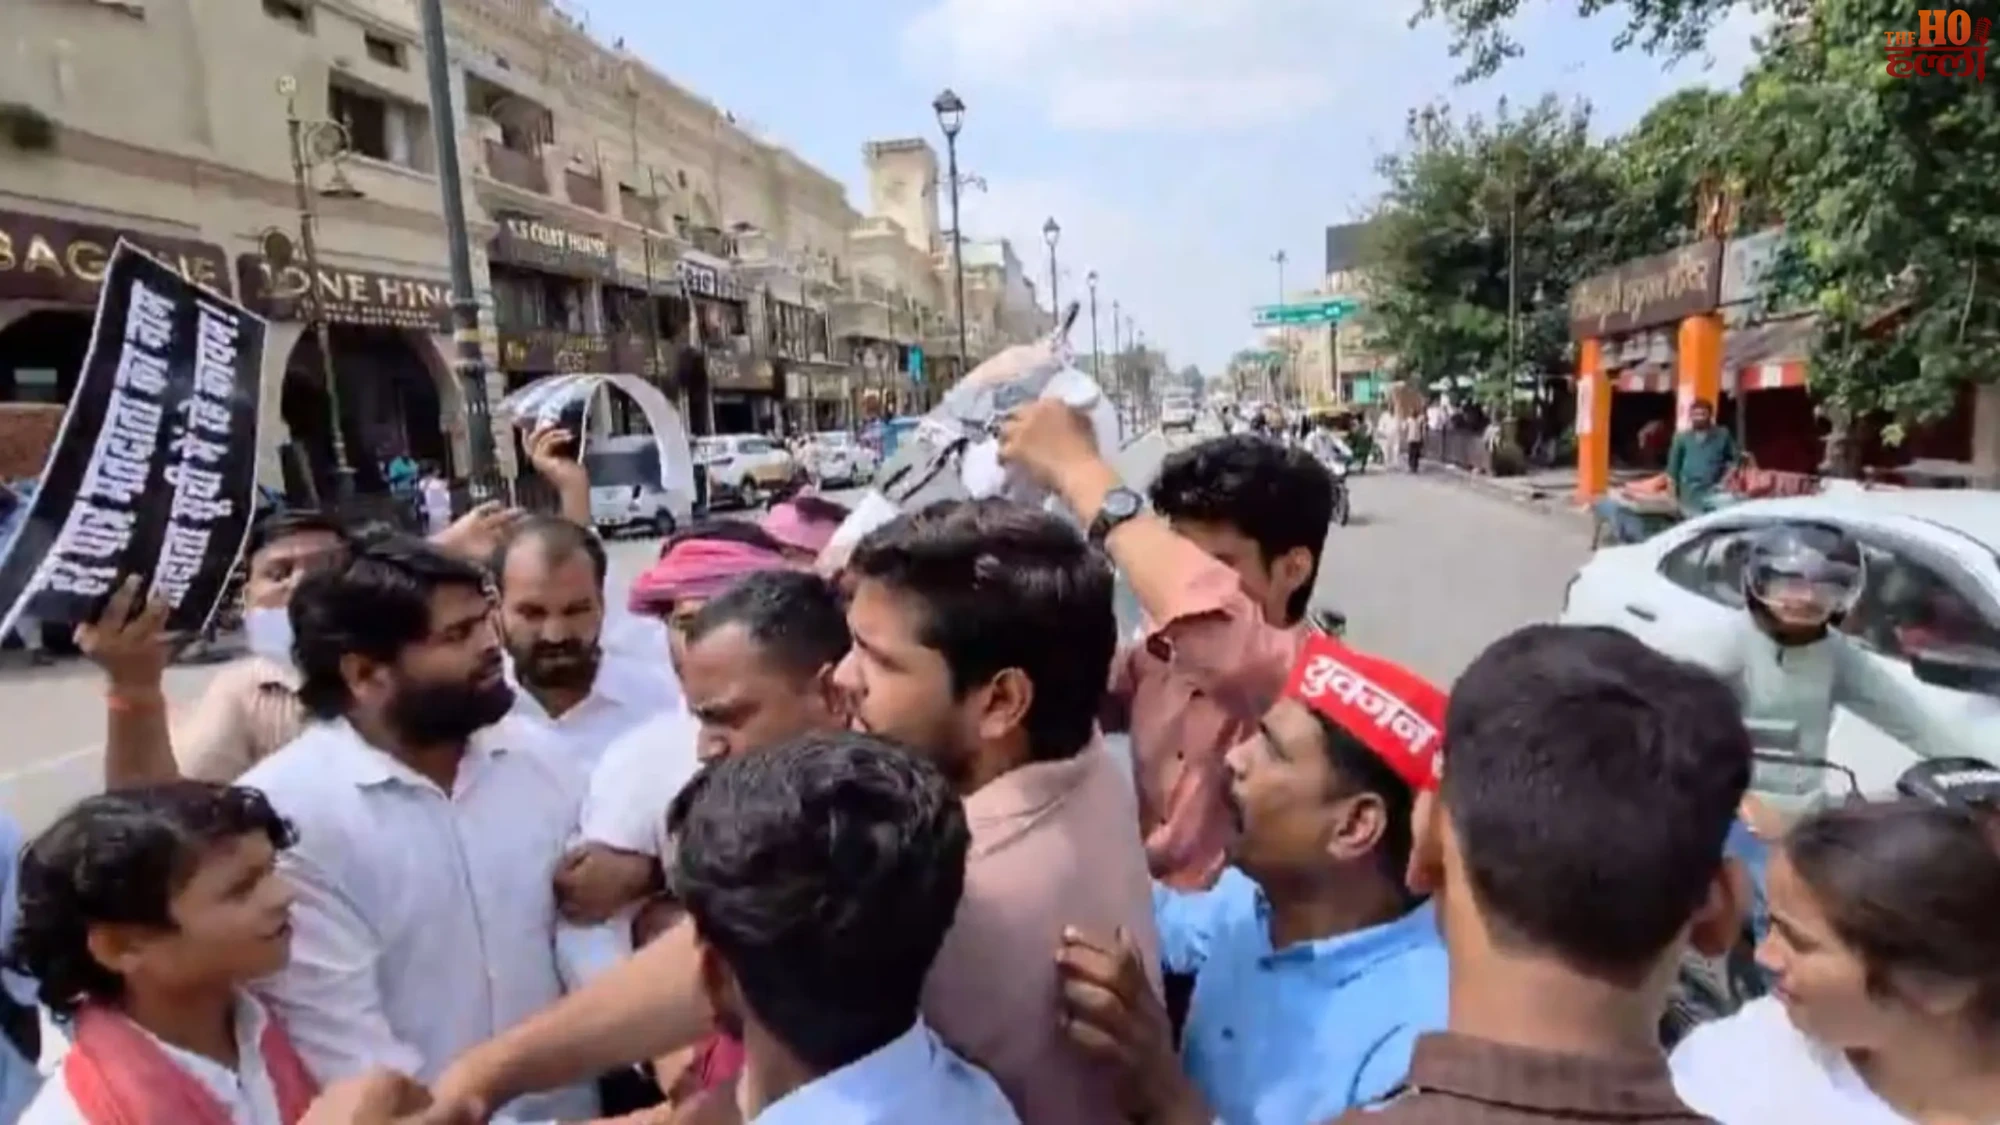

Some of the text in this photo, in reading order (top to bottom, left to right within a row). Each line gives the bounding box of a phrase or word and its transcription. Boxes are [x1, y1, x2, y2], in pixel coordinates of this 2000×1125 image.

[78, 388, 163, 502] मतदाता
[169, 426, 228, 463] में
[163, 463, 233, 521] सूची
[1299, 654, 1441, 754] युवजन
